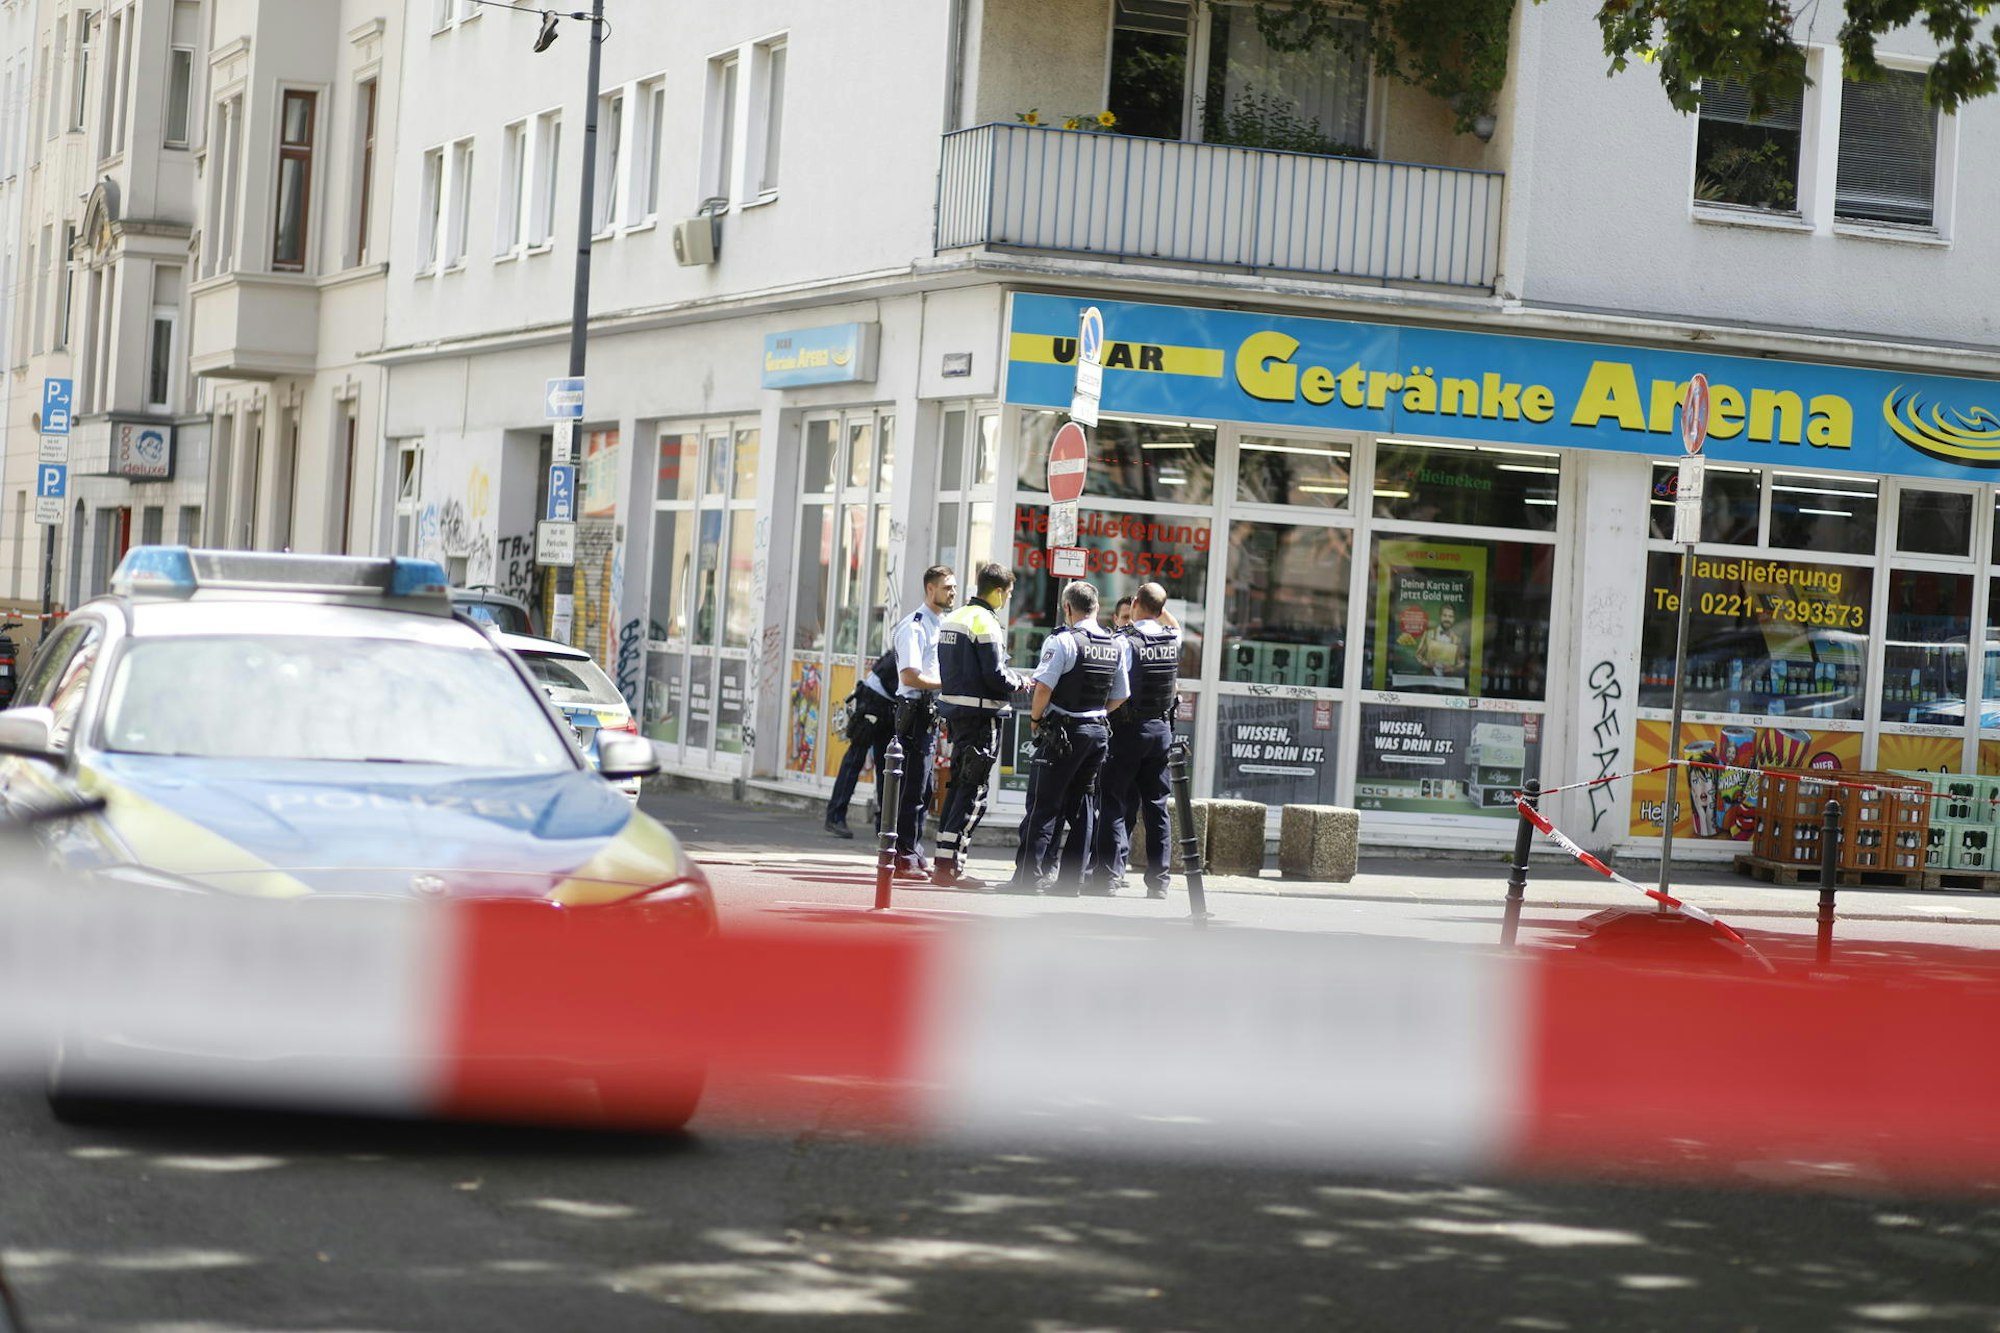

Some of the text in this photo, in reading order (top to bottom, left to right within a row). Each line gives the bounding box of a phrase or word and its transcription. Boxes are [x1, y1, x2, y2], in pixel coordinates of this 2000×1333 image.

[1053, 337, 1164, 372] UAR
[1235, 330, 1854, 450] Getränke Arena
[122, 461, 166, 475] deluxe
[1419, 469, 1493, 491] Heineken
[1015, 507, 1211, 551] Haslieferung
[1088, 548, 1185, 579] 393573
[1400, 578, 1464, 591] Deine Karte ist
[1400, 589, 1465, 602] jetzt Gold wert.
[1653, 588, 1693, 614] Te.
[1771, 598, 1864, 627] 7393573
[1084, 645, 1118, 661] POLIZEI
[1140, 645, 1177, 661] POLIZEI
[1236, 725, 1291, 745] WISSEN,
[1379, 720, 1425, 738] WISSEN,
[1231, 743, 1325, 762] WAS DRIN IST.
[1374, 737, 1454, 753] WAS DRIN IST.
[265, 792, 536, 820] POLIZEI
[1641, 800, 1680, 822] Hel!
